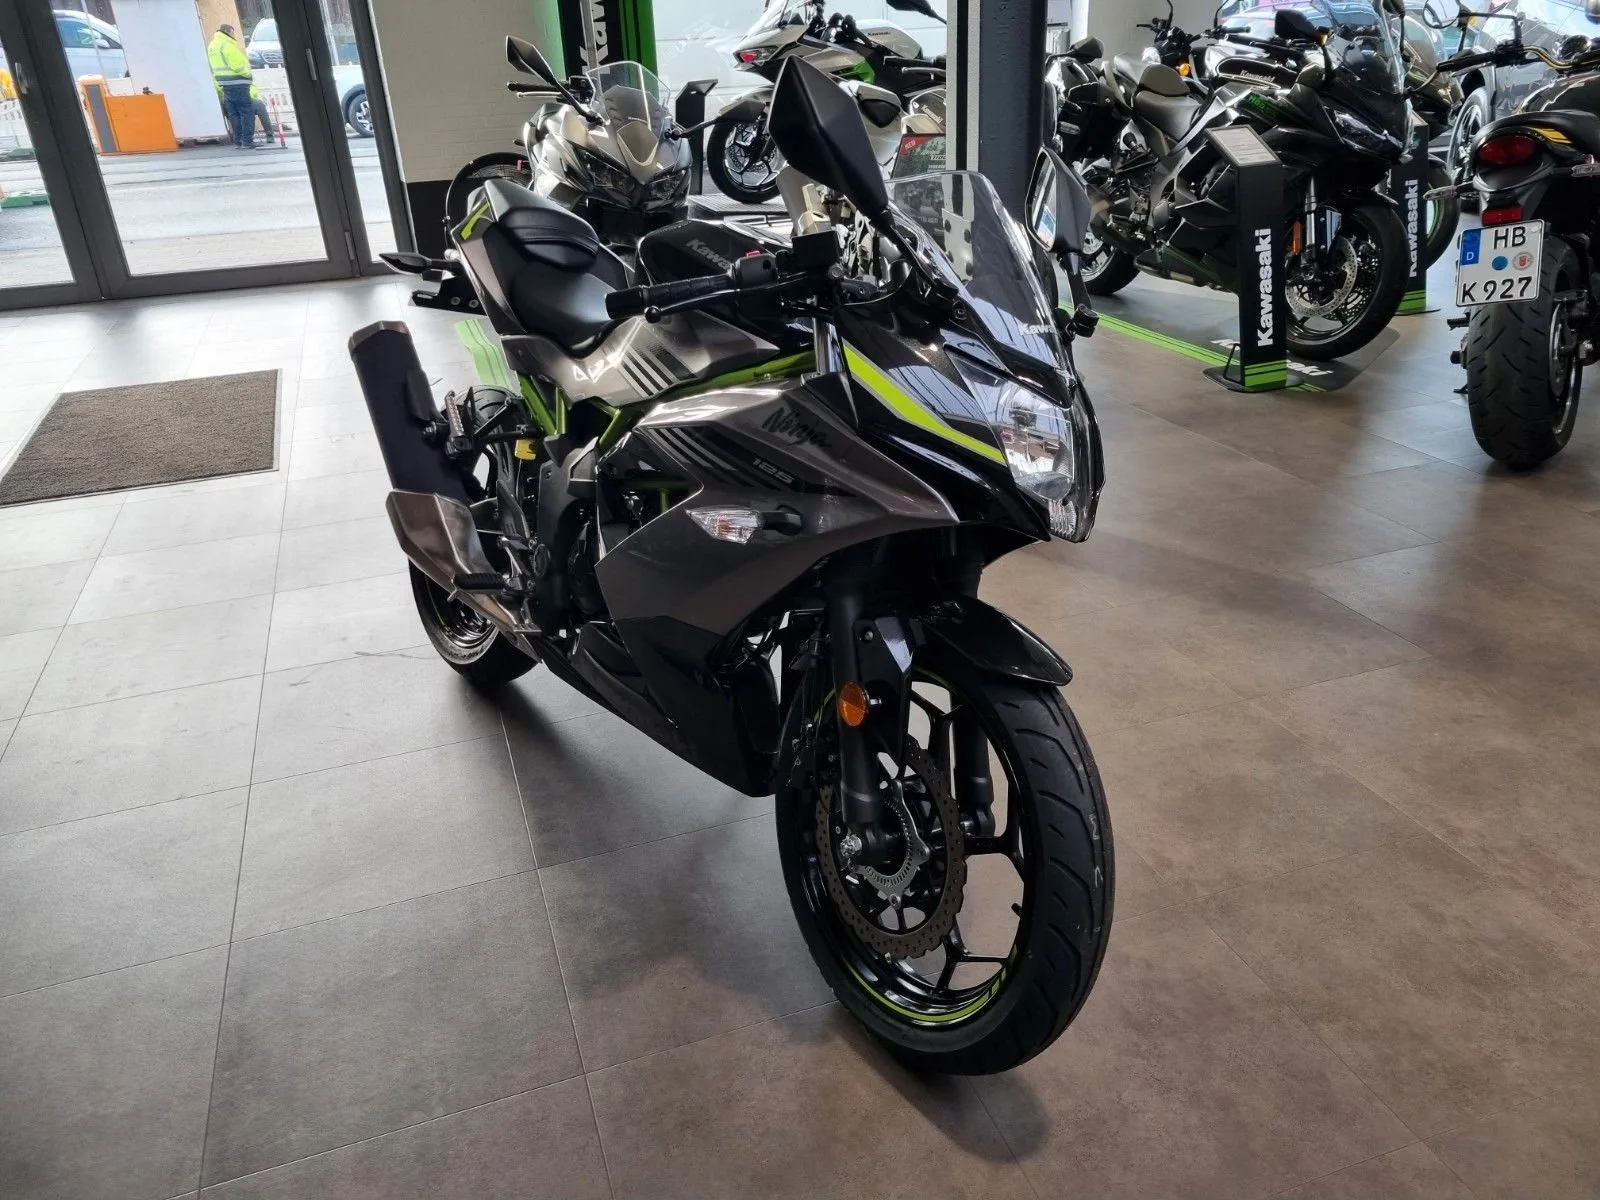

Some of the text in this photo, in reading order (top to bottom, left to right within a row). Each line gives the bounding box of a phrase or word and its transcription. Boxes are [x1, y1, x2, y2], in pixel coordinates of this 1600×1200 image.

[1493, 226, 1526, 250] HB
[1466, 251, 1474, 261] D
[1255, 228, 1273, 347] Kawasaki
[1461, 276, 1532, 303] K 927
[761, 407, 832, 448] Ninja
[752, 458, 795, 484] 125
